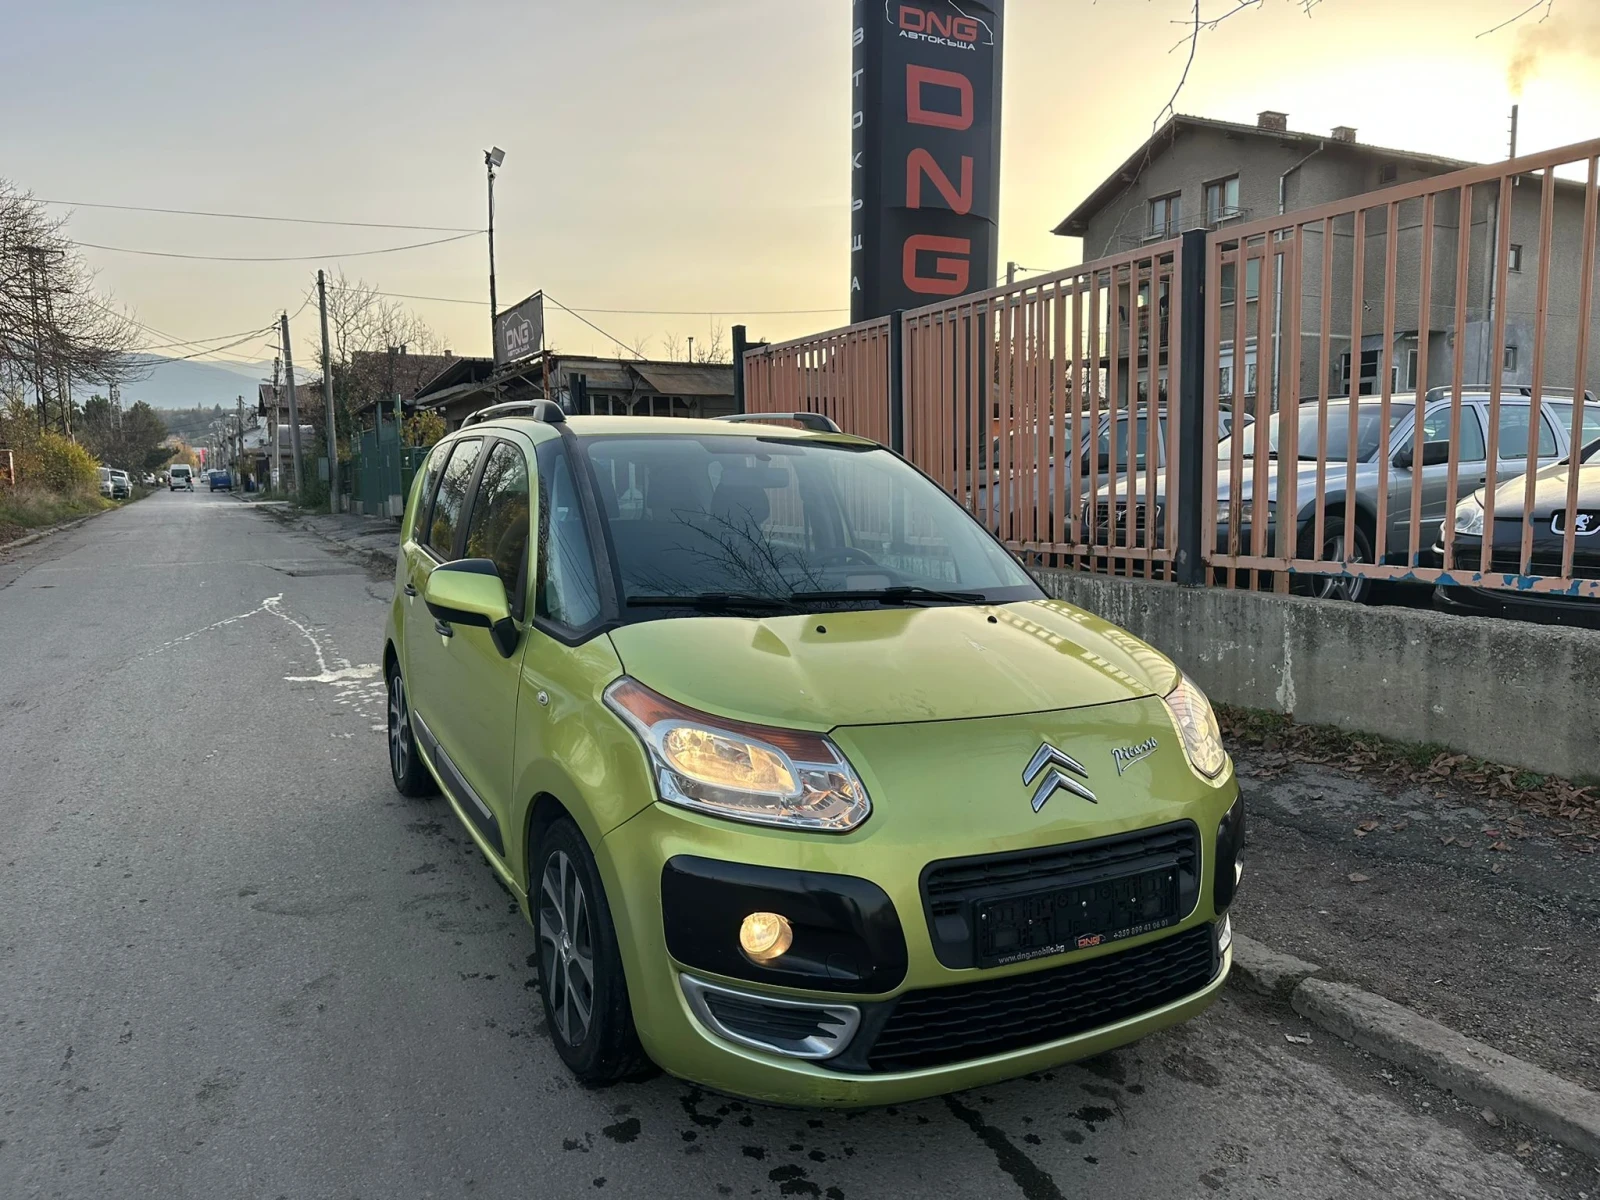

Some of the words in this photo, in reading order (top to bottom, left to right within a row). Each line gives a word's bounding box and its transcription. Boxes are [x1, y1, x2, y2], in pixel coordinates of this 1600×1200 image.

[899, 5, 978, 42] DNG
[899, 29, 976, 51] АВТОКЪЩА
[851, 0, 864, 292] ВТОКЪЩА
[903, 63, 974, 295] DNG
[507, 322, 528, 350] DNG
[998, 943, 1065, 964] www.dng.mobile.bg
[1078, 935, 1100, 948] DNG
[1113, 928, 1130, 938] +359
